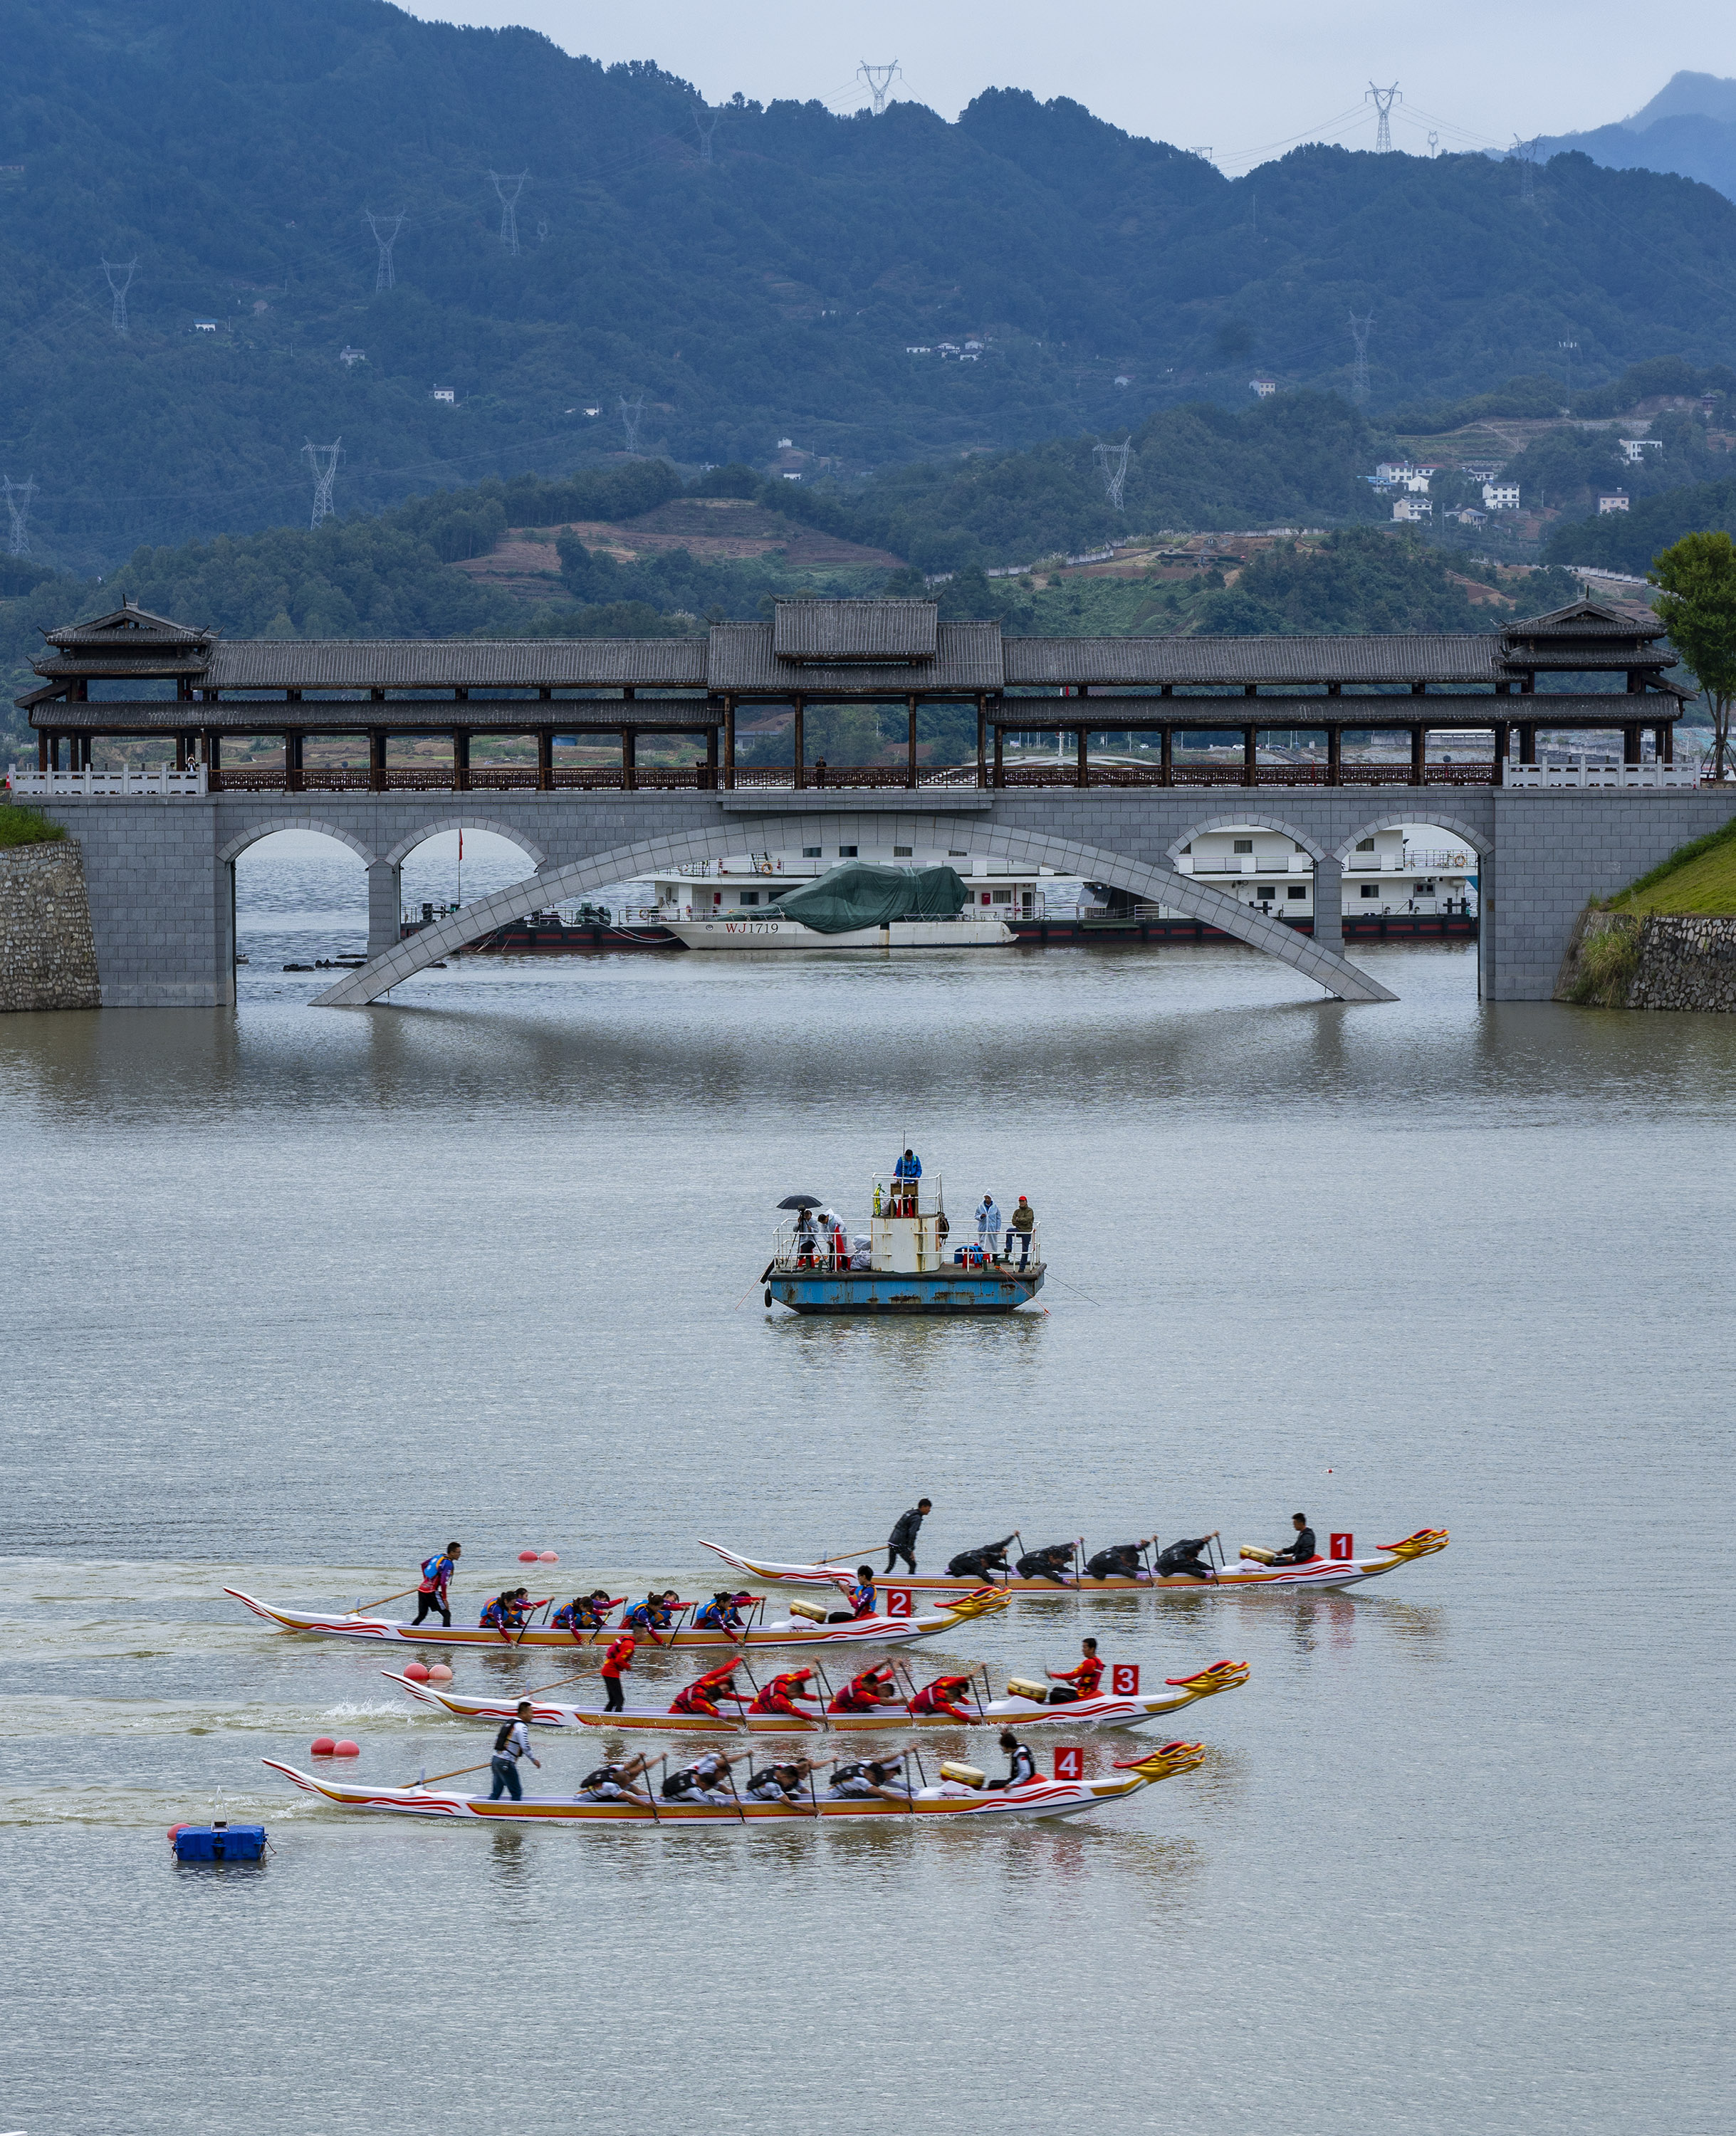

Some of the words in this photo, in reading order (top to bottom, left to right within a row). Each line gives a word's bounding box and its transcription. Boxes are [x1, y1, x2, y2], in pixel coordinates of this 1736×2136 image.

[725, 923, 779, 933] WJ1719
[1337, 1536, 1347, 1556] 1
[891, 1592, 907, 1614] 2
[1117, 1668, 1134, 1692] 3
[1058, 1752, 1079, 1776] 4
